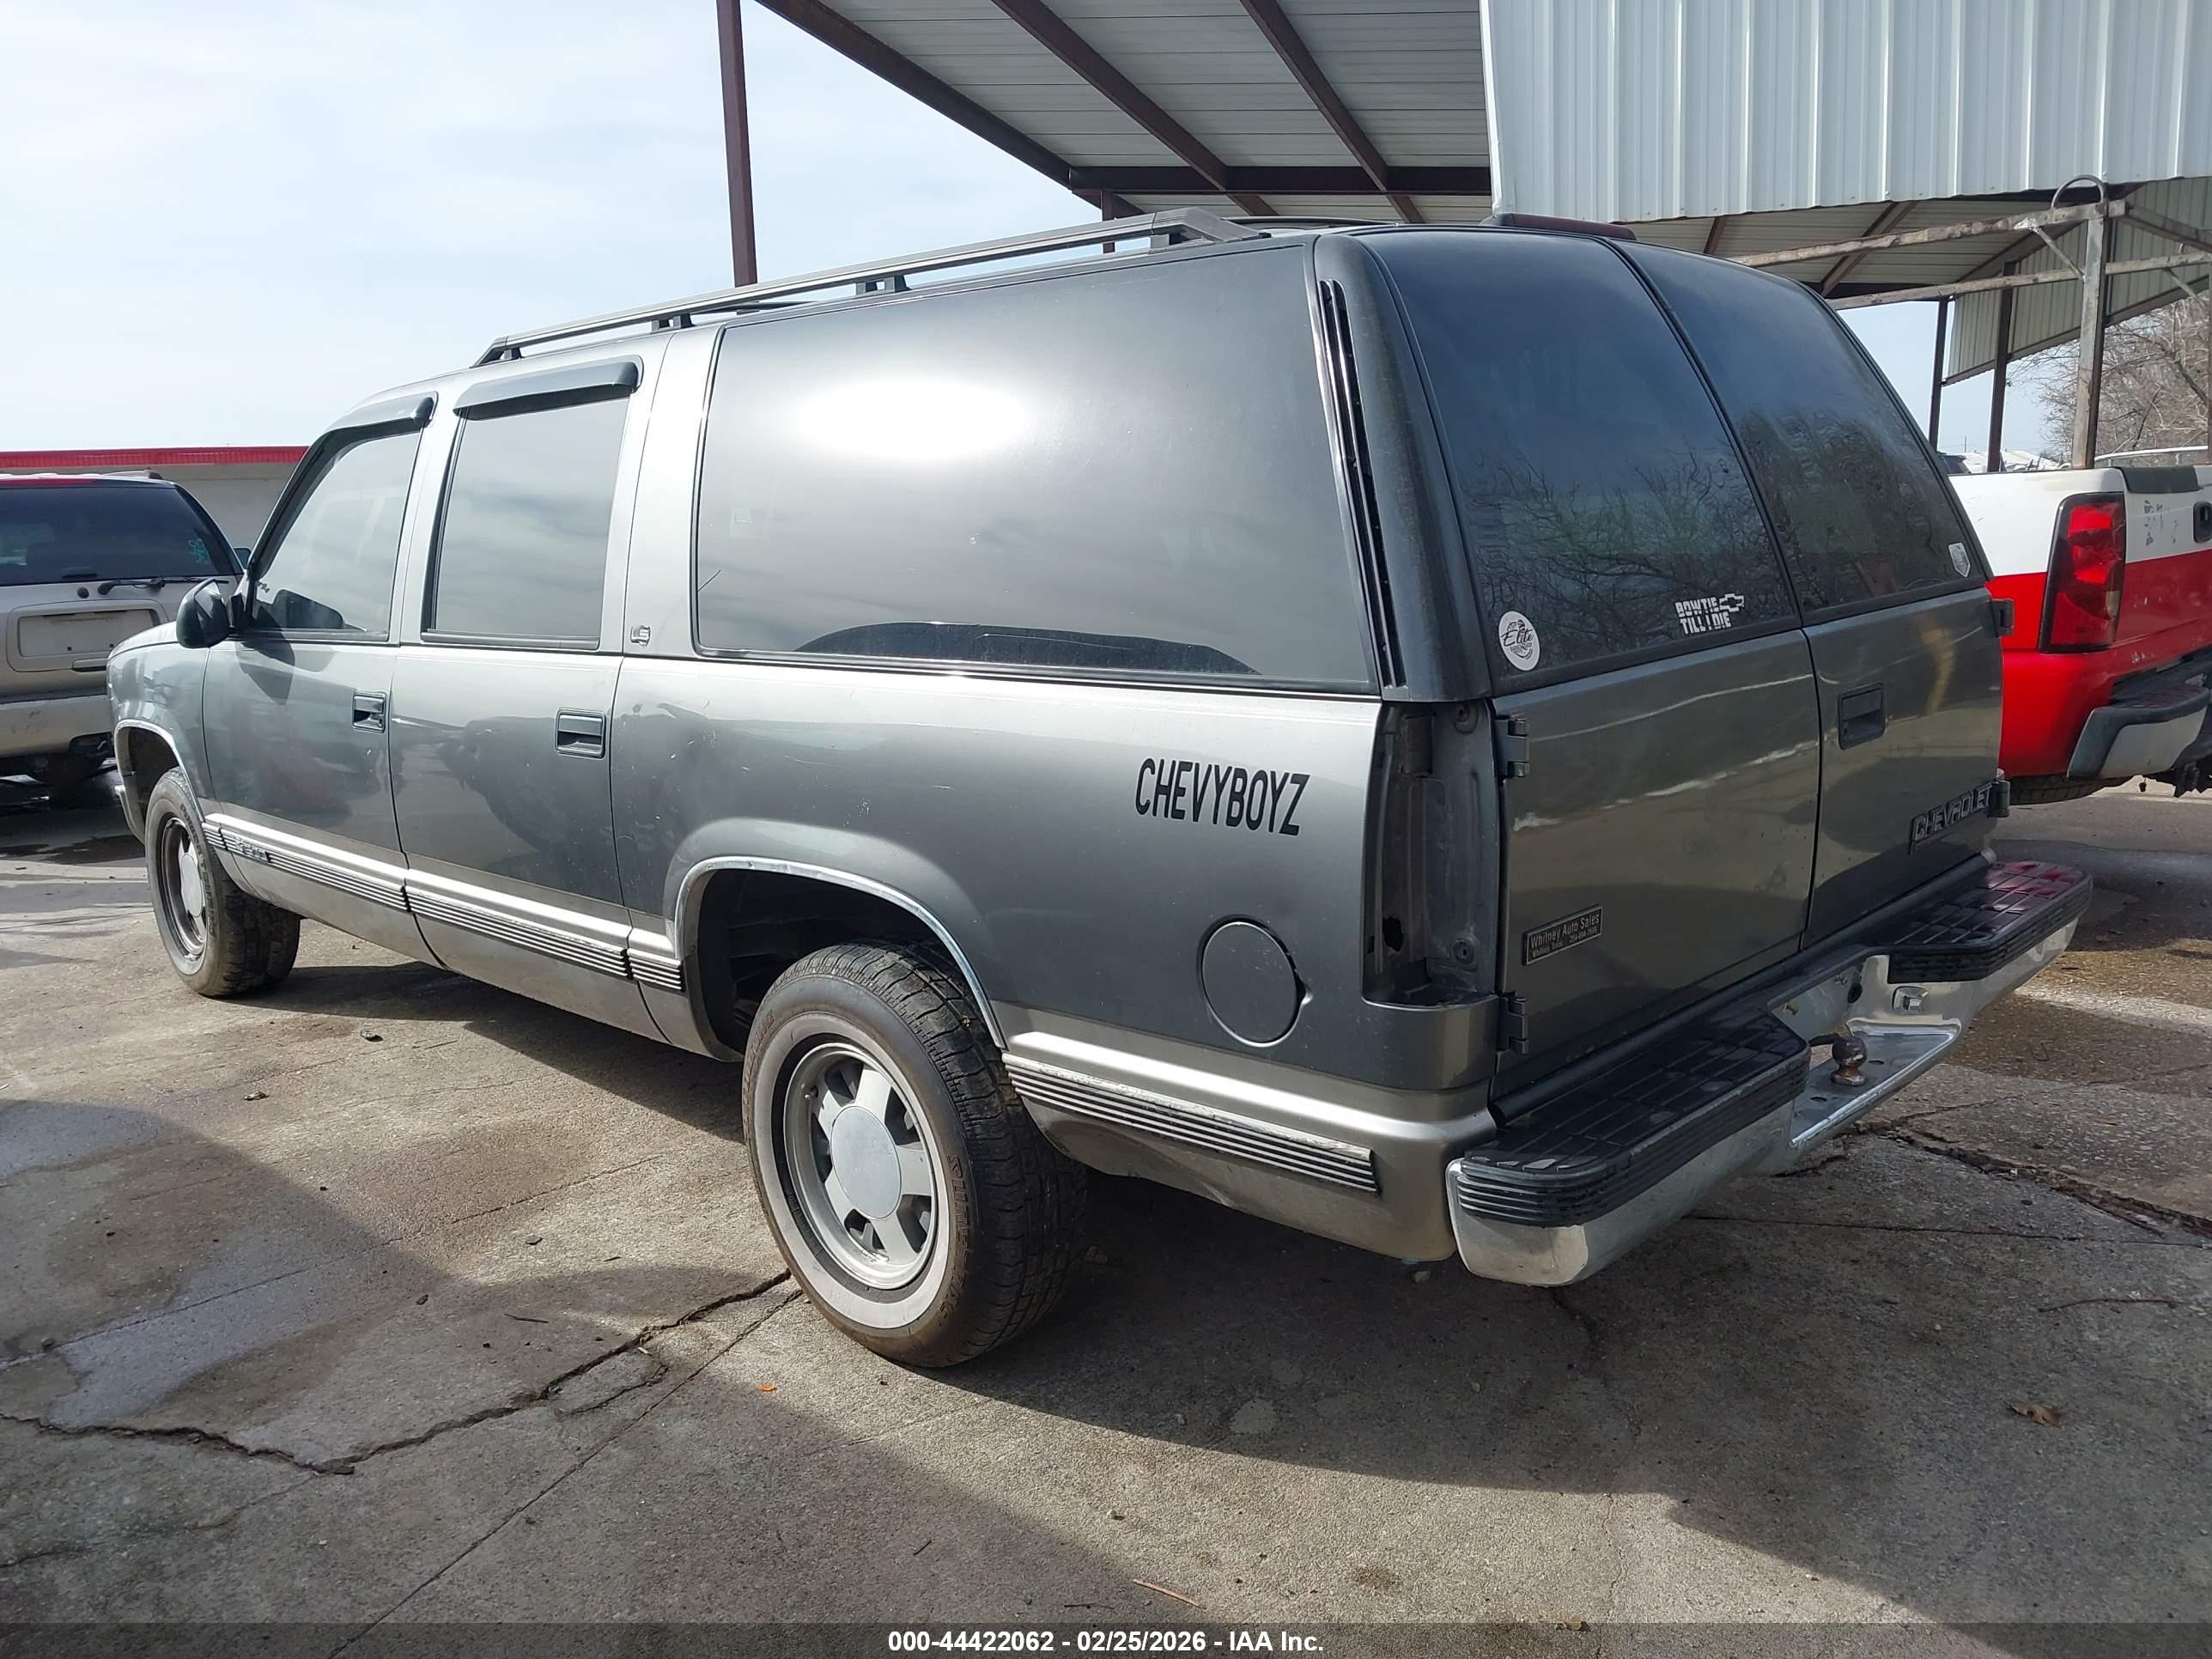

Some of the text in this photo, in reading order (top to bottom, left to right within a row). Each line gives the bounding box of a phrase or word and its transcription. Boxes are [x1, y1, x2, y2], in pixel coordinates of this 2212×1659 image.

[1674, 597, 1719, 617] BOWTIE
[1680, 616, 1706, 634] TILL
[1711, 611, 1732, 629] DIE
[1501, 628, 1534, 647] Elite
[1135, 758, 1310, 836] CHEVYBOYZ
[1912, 782, 1992, 842] CHEVROLET
[1530, 914, 1600, 949] Whitney Auto Sales
